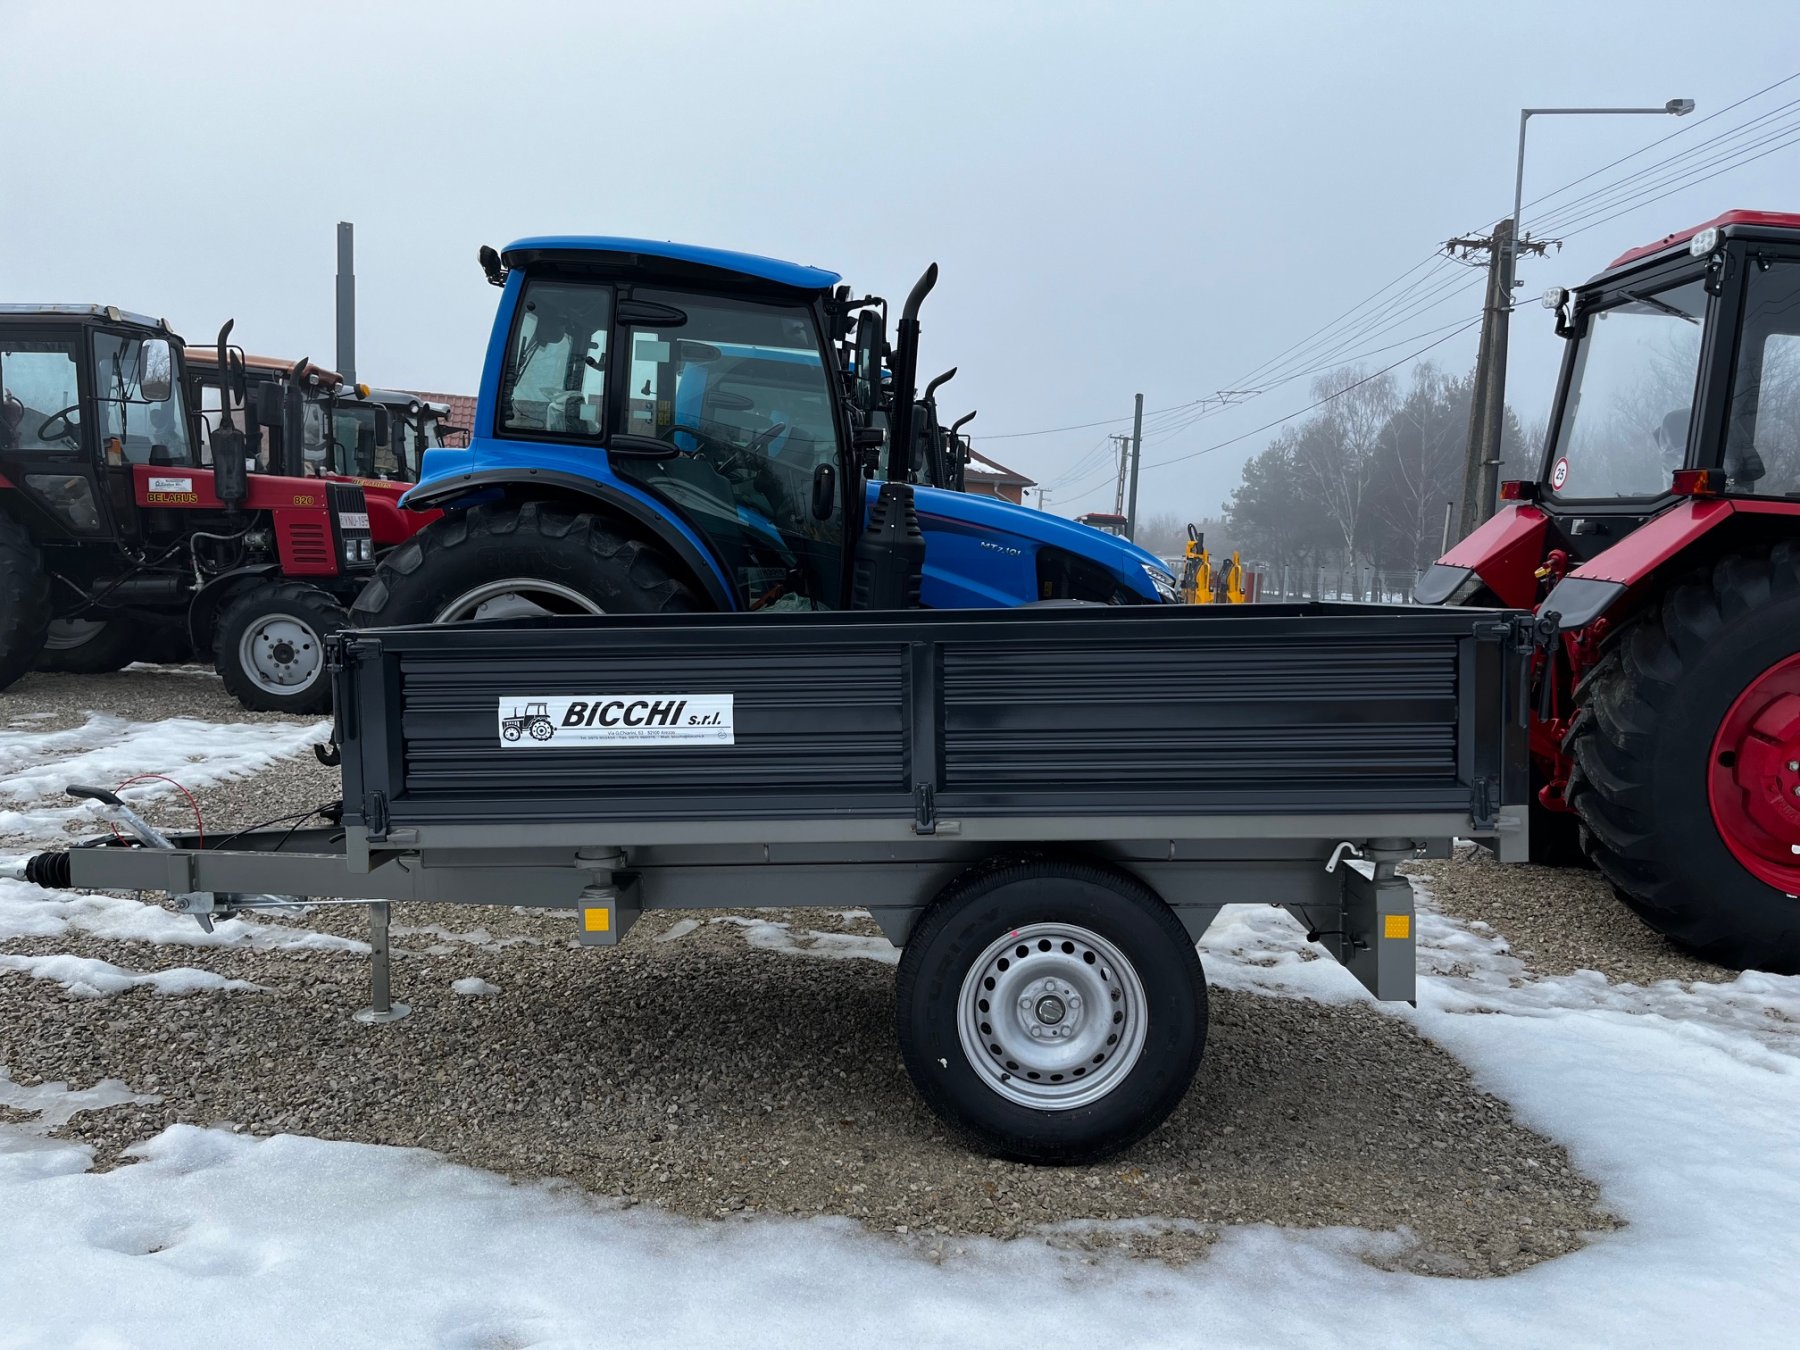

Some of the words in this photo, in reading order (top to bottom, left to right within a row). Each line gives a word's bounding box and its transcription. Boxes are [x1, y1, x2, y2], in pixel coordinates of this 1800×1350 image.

[1556, 468, 1565, 480] 25
[147, 493, 198, 503] BELARUS
[561, 700, 687, 726] BICCHI
[688, 711, 722, 725] s.r.l.
